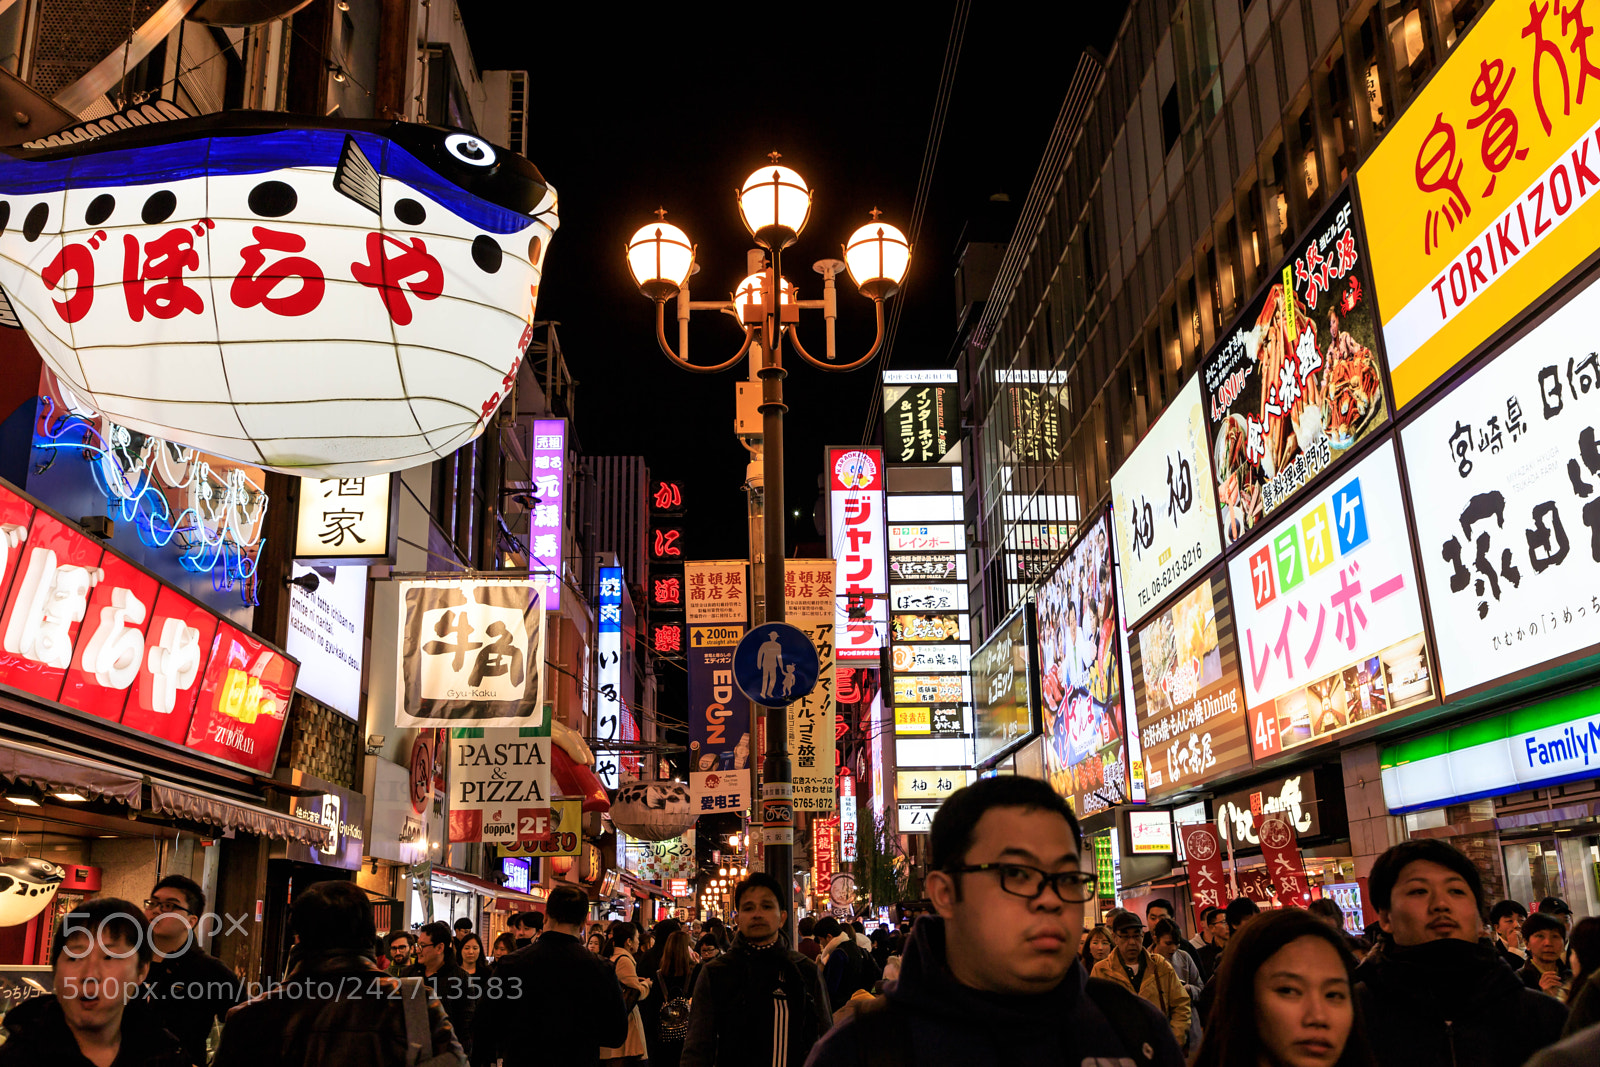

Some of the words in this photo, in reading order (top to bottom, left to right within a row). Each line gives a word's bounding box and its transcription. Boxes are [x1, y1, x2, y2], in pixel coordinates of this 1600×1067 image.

[41, 217, 444, 326] づぼらや
[900, 400, 916, 462] &コミック
[916, 387, 934, 462] インターネット
[1448, 395, 1528, 478] 宮崎県
[537, 438, 561, 449] 元祖
[1262, 437, 1331, 513] 蟹料理専門店
[898, 537, 951, 549] レインボー
[1252, 491, 1361, 604] カラオケ
[690, 572, 741, 586] 道頓堀
[600, 577, 620, 622] 焼肉
[690, 586, 743, 600] 商店会
[1137, 585, 1151, 608] TEL
[707, 629, 738, 640] 200m
[1246, 559, 1406, 695] レインボー
[422, 609, 524, 687] 牛角
[447, 689, 497, 697] Gyu-Kaku
[1203, 688, 1238, 720] Dining
[214, 726, 255, 755] ZUBORAYA
[1255, 711, 1275, 751] 4F
[458, 743, 545, 766] PASTA
[1167, 732, 1216, 783] ぼて茶屋
[491, 766, 508, 780] &
[460, 779, 544, 803] PIZZA
[339, 820, 363, 840] Gyu-Kaku
[484, 823, 516, 836] doppa!
[520, 817, 548, 834] 2F
